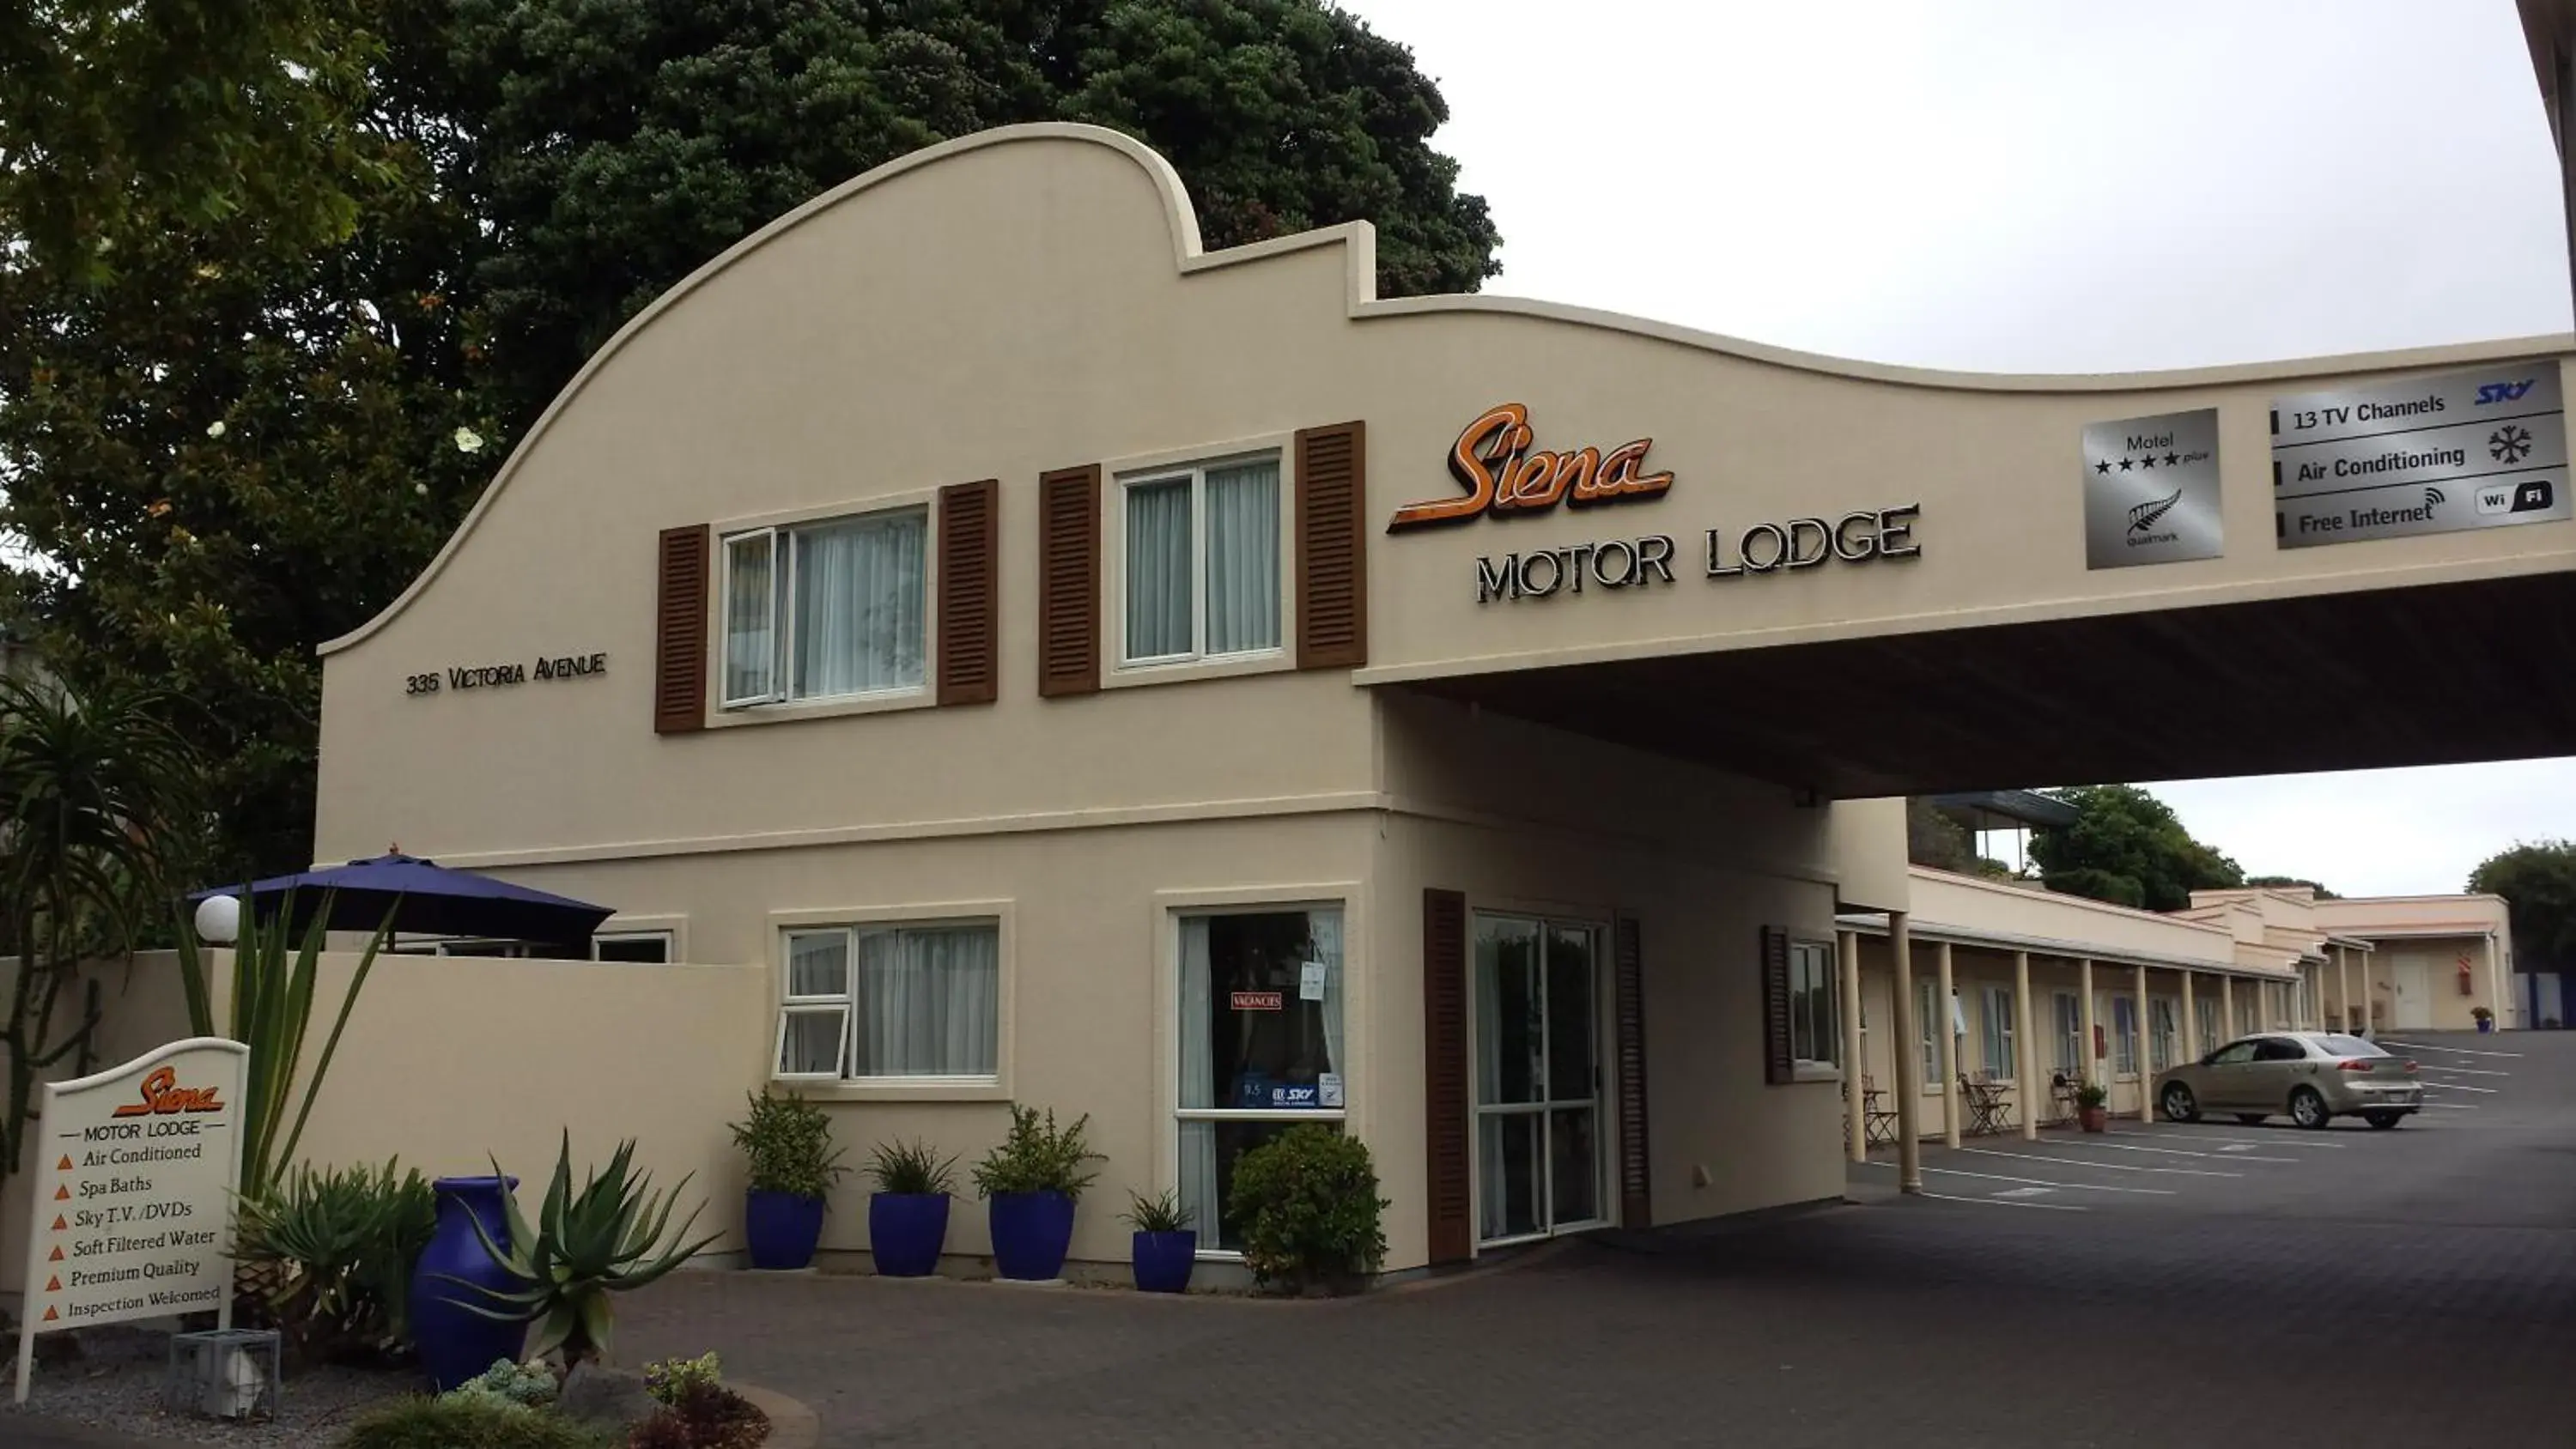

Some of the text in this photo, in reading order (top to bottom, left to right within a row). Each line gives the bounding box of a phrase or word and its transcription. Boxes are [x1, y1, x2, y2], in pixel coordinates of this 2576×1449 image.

[2293, 395, 2445, 430] 13 TV Channels
[2127, 431, 2173, 452] Motel
[1386, 403, 1674, 535] Siena
[2298, 447, 2465, 482] Air Conditioning
[2484, 494, 2506, 506] Wi
[2299, 503, 2433, 533] Free Internet
[1476, 502, 1921, 603] MOTOR LODGE
[406, 672, 440, 694] 335
[1234, 996, 1280, 1007] VACANCIES
[112, 1066, 225, 1118] Siena
[84, 1120, 200, 1142] MOTOR LODGE
[82, 1143, 202, 1167] Air Conditioned
[79, 1176, 152, 1199] Spa Baths
[75, 1210, 103, 1228] Sky
[73, 1230, 216, 1258] Soft Filtered Water
[70, 1260, 200, 1287] Premium Quality
[69, 1285, 221, 1318] Inspection Welcomed
